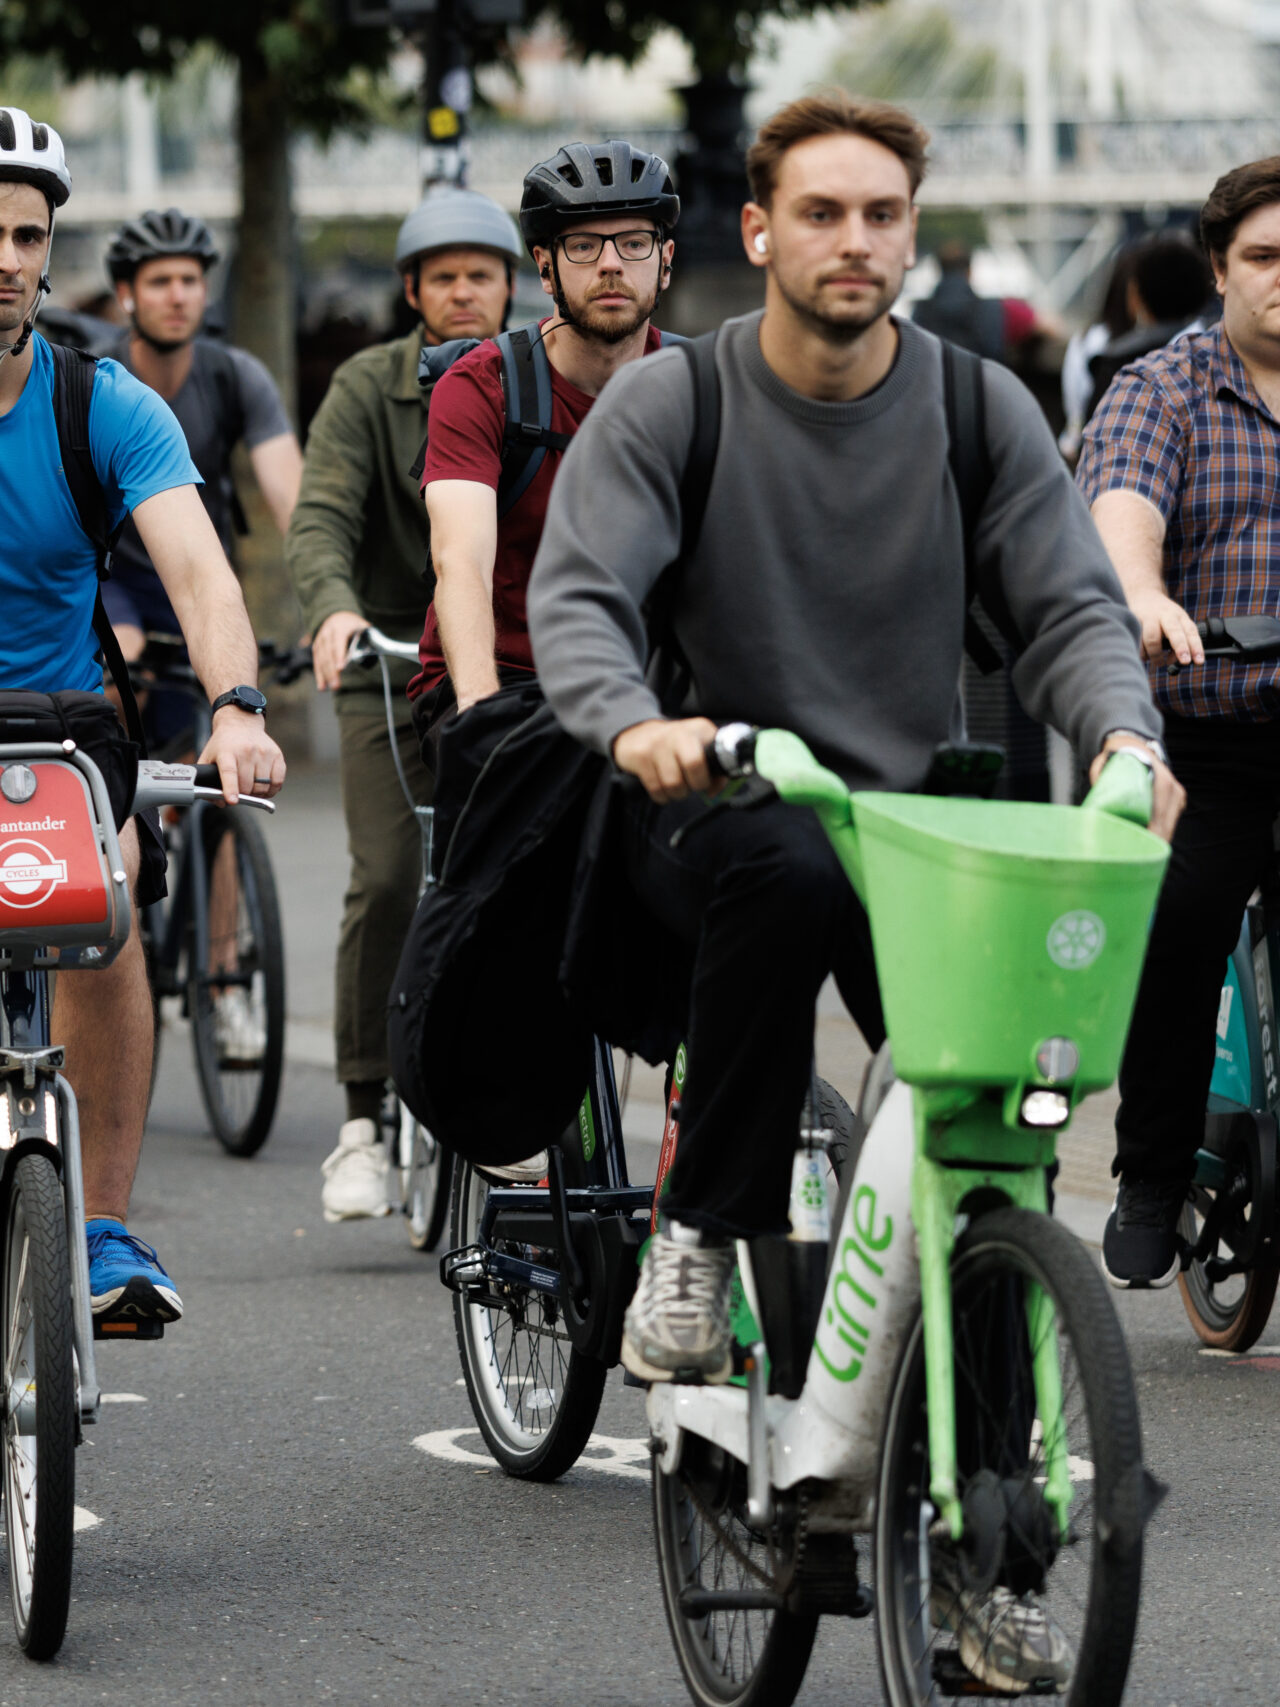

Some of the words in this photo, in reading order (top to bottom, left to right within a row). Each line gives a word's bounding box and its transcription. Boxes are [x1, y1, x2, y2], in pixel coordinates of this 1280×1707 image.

[5, 869, 39, 878] CYCLES
[1254, 957, 1277, 1099] forest
[580, 1099, 591, 1156] ectric
[814, 1184, 893, 1383] Lime
